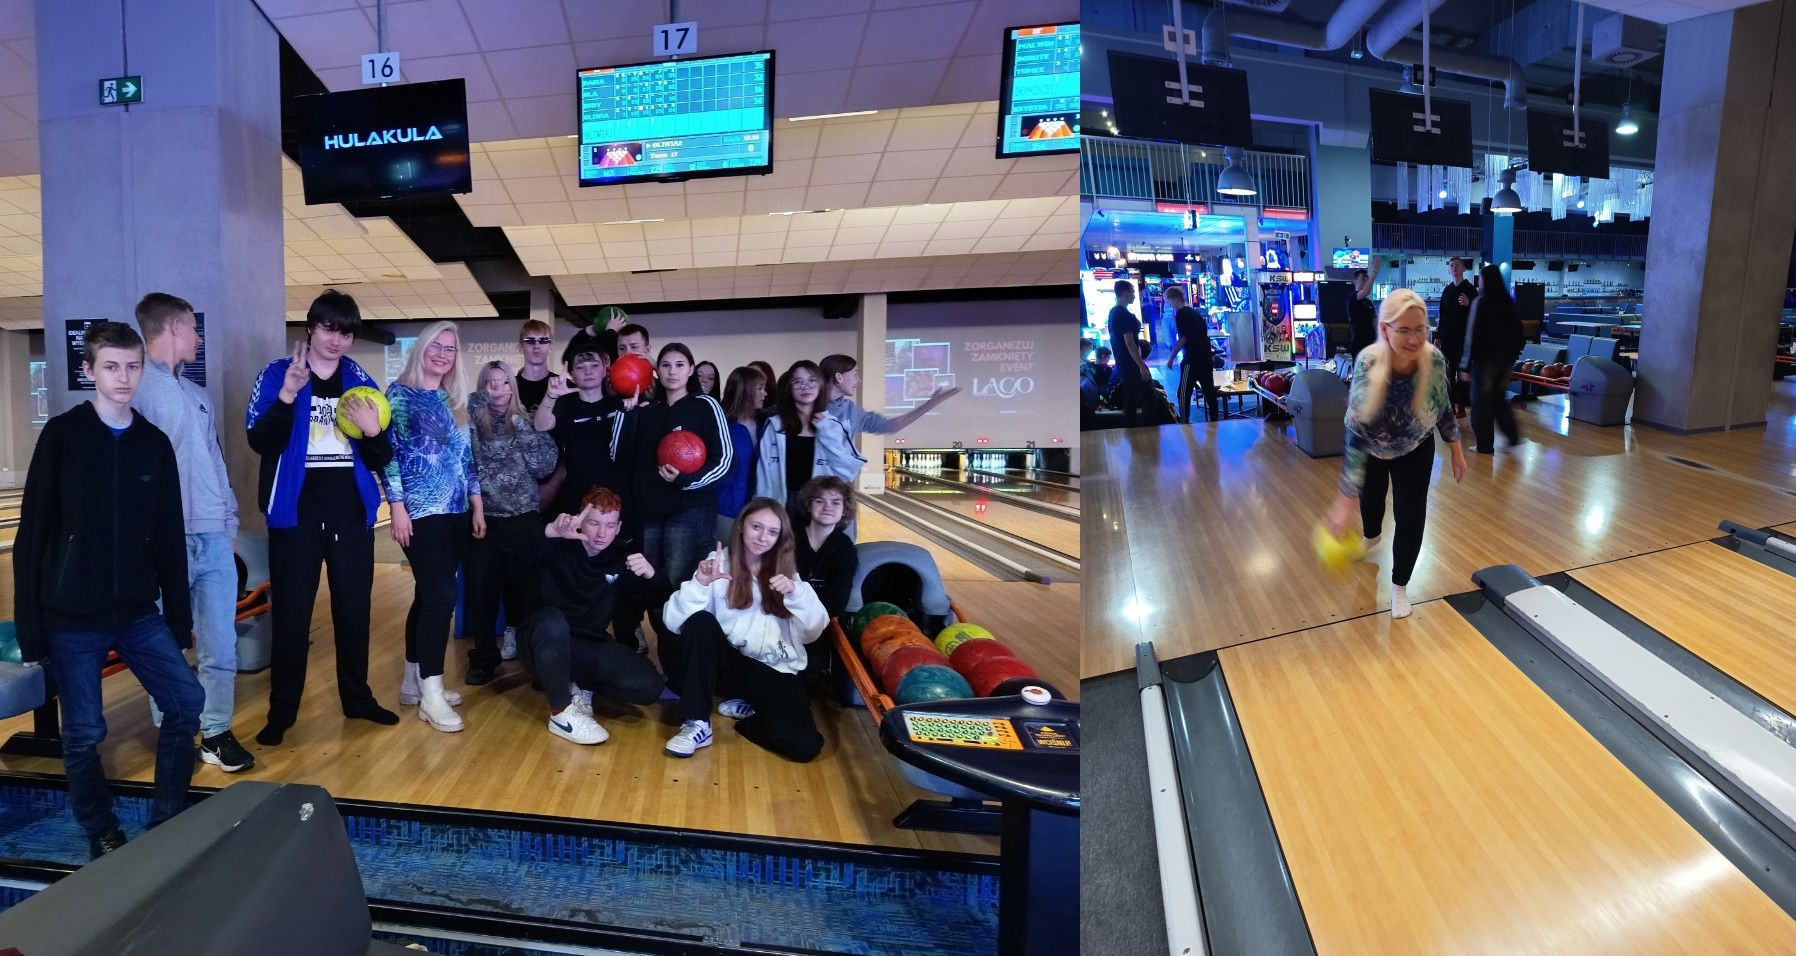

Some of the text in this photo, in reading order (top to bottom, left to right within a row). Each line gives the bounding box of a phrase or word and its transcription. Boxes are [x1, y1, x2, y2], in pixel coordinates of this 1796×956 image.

[660, 27, 690, 50] 17
[368, 57, 394, 78] 16
[324, 125, 443, 149] HULAKULA
[467, 342, 519, 353] ZORGANI
[964, 341, 1035, 351] ZORGANIZUJ
[1000, 362, 1034, 372] EVENT
[952, 441, 963, 449] 20
[1026, 440, 1036, 448] 21
